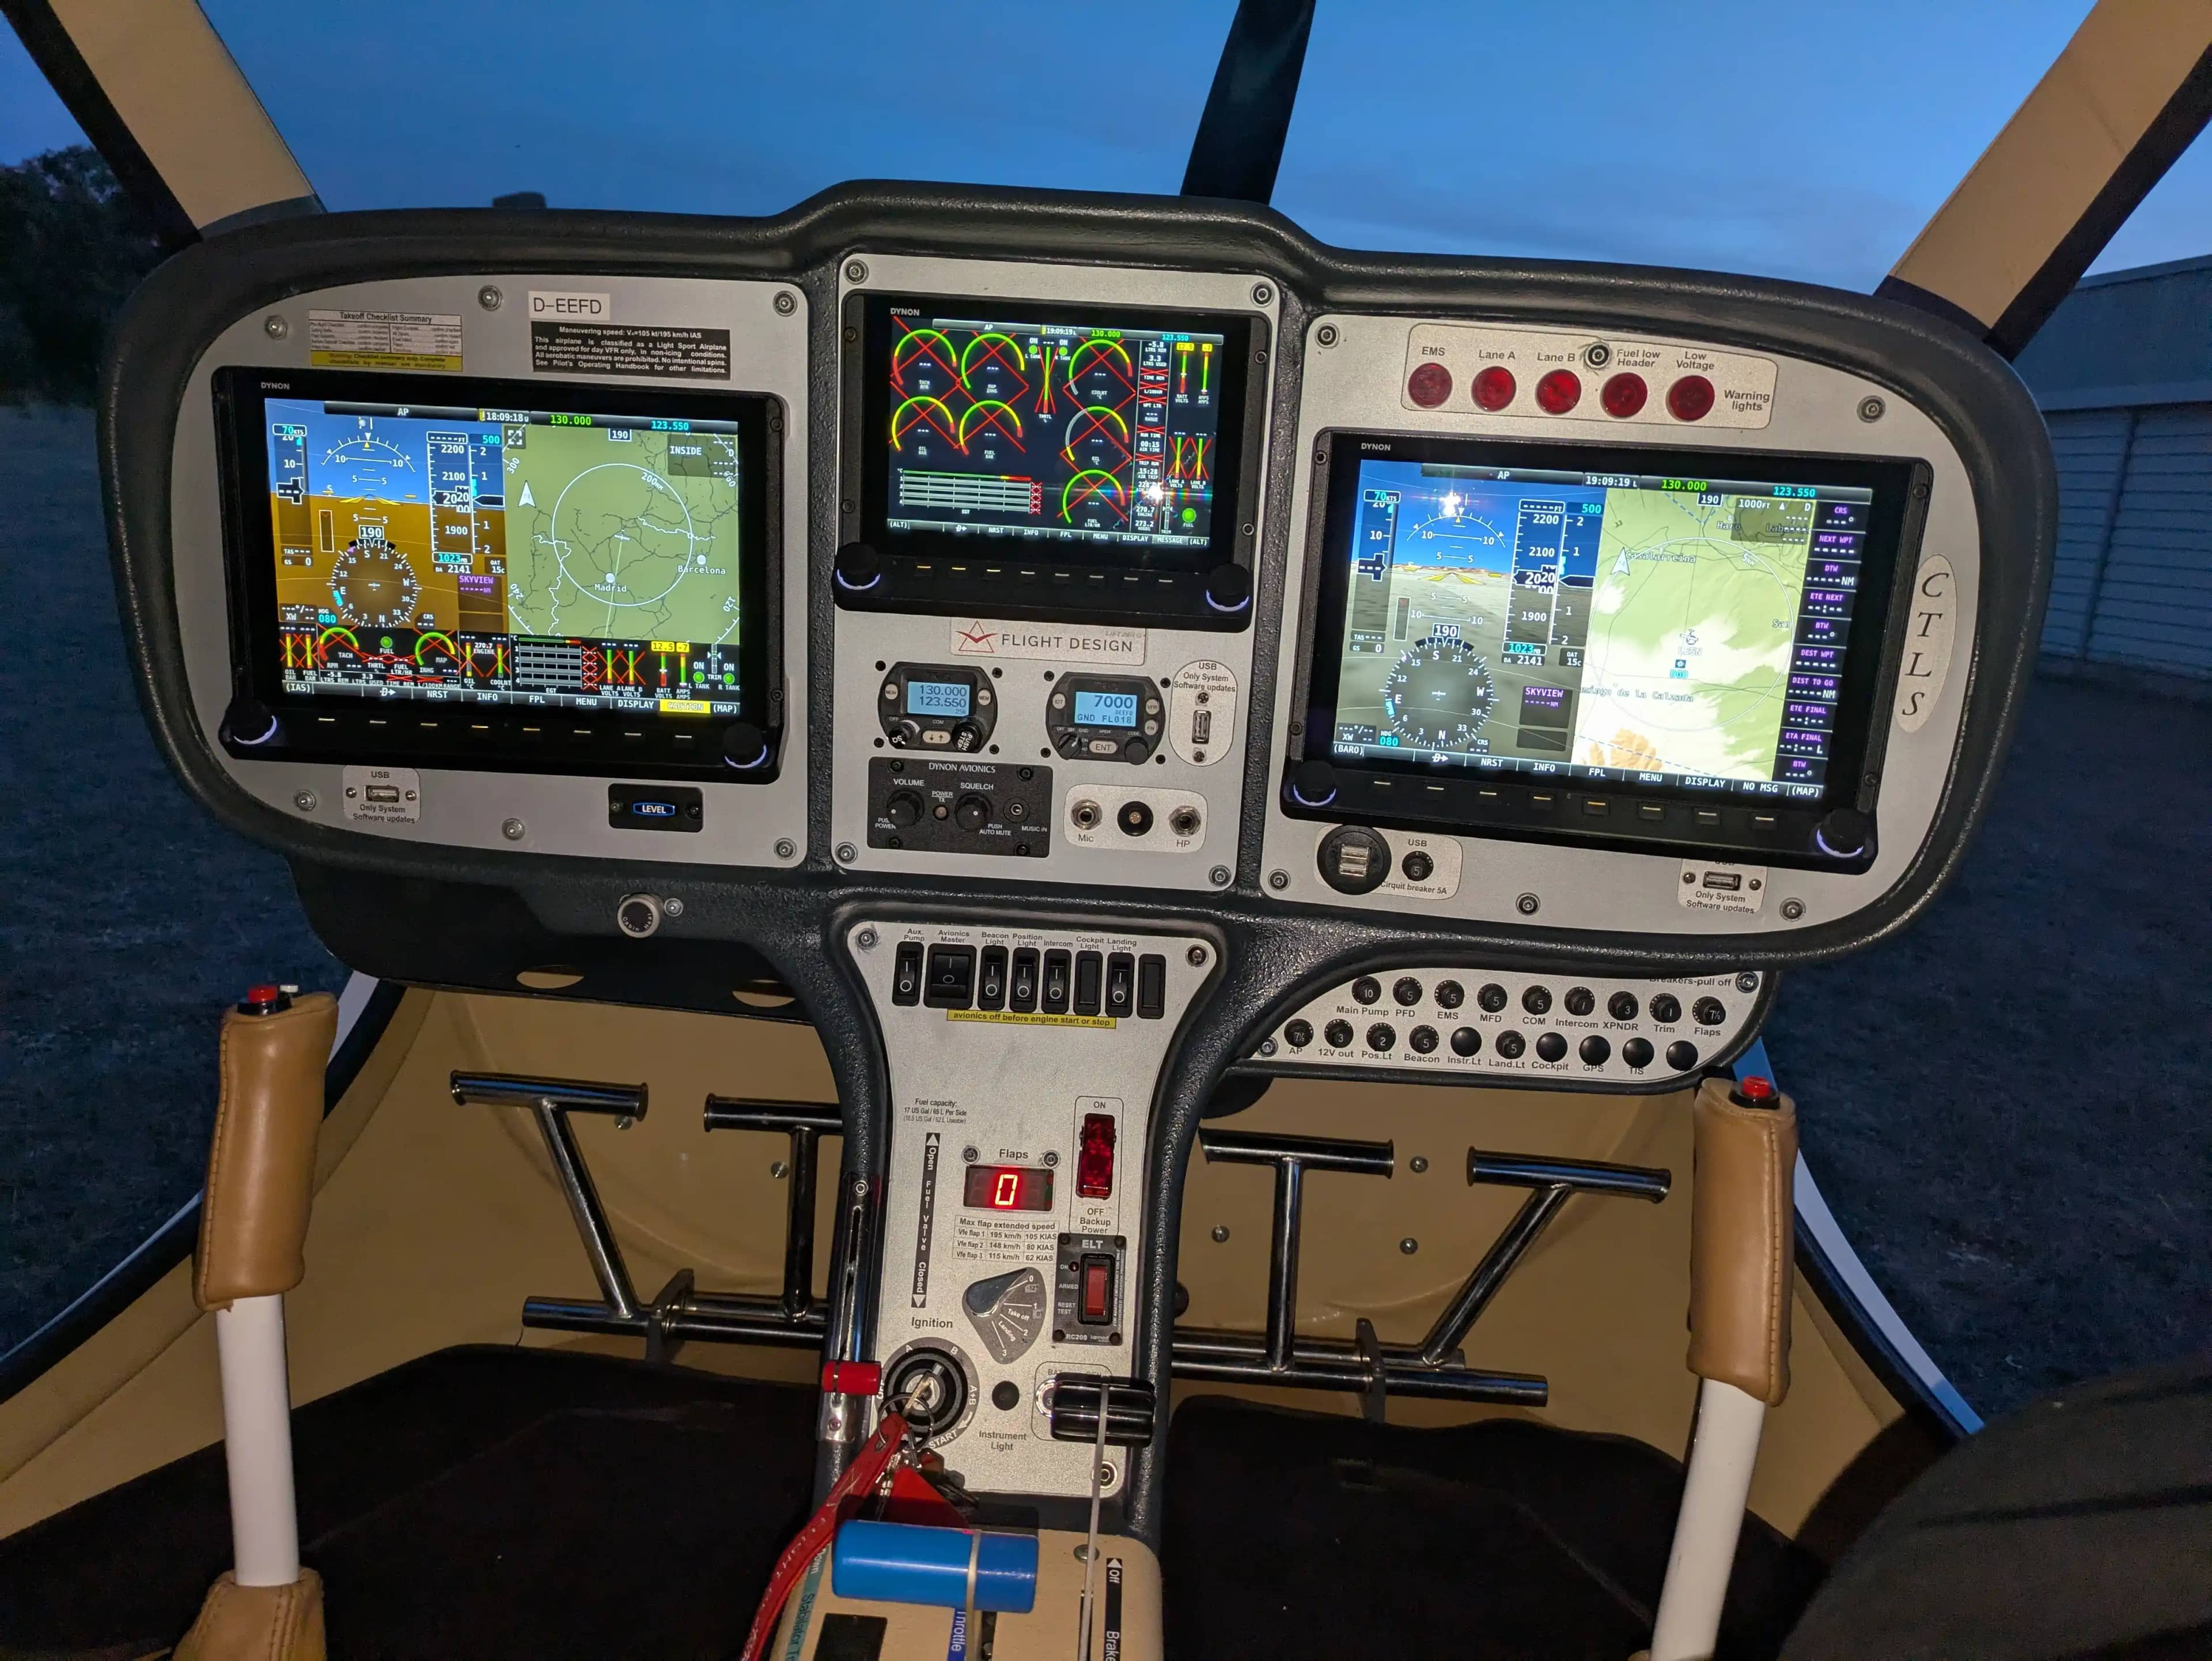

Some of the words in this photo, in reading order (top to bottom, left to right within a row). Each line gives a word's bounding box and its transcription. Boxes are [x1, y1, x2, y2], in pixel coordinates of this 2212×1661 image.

[533, 297, 602, 314] D-EEFD
[891, 308, 919, 316] DYNON
[340, 312, 365, 320] Takeoff
[366, 313, 398, 321] Checklist
[400, 315, 432, 324] Summary
[559, 327, 601, 335] Maneuvering
[603, 328, 625, 337] speed:
[1092, 330, 1120, 338] 130.000
[1422, 346, 1445, 357] EMS
[1479, 350, 1505, 360] Lane
[1508, 350, 1516, 360] A
[1617, 349, 1639, 359] Fuel
[1642, 350, 1661, 360] low
[1684, 351, 1707, 361] Low
[1537, 353, 1564, 362] Lane
[1567, 353, 1575, 362] B
[578, 361, 611, 370] Operating
[1618, 358, 1656, 368] Header
[1676, 360, 1714, 372] Voltage
[1724, 389, 1770, 403] Warning
[1732, 400, 1763, 413] lights
[550, 415, 592, 425] 130.000
[652, 421, 689, 430] 123.550
[441, 445, 464, 453] 2200
[670, 446, 702, 456] INSIDE
[1361, 443, 1391, 451] DYNON
[1661, 480, 1707, 491] 130.000
[1773, 486, 1816, 497] 123.550
[677, 565, 726, 575] Barcelona
[459, 576, 493, 584] SKYVIEW
[594, 584, 627, 593] Madrid
[1002, 634, 1063, 648] FLIGHT
[1070, 638, 1132, 652] DESIGN
[1902, 573, 1949, 716] CTLS
[1183, 672, 1200, 680] Only
[1202, 674, 1229, 683] System
[919, 685, 967, 697] 130.000
[1174, 681, 1205, 690] Software
[1207, 684, 1235, 692] updates
[427, 690, 448, 698] NRST
[618, 700, 654, 709] DISPLAY
[713, 705, 737, 713] (MAP)
[919, 697, 966, 707] 123.550
[1094, 695, 1133, 709] 7000
[1102, 716, 1131, 724] FL018
[1096, 743, 1111, 751] ENT
[929, 763, 957, 771] DYNON
[959, 765, 995, 773] AVIONICS
[1589, 768, 1605, 777] FPL
[1639, 773, 1662, 782] MENU
[1685, 777, 1726, 787] DISPLAY
[1791, 786, 1819, 797] (MAP)
[360, 804, 376, 812] Only
[378, 805, 405, 814] System
[642, 805, 666, 814] LEVEL
[353, 814, 385, 822] Software
[387, 815, 415, 823] updates
[1078, 834, 1093, 842] Mic
[1176, 840, 1190, 848] HP
[1381, 880, 1406, 890] Cirquit
[1407, 884, 1435, 893] breaker
[1696, 891, 1714, 901] Only
[1716, 893, 1745, 902] System
[1687, 900, 1721, 910] Software
[1723, 906, 1754, 914] updates
[1107, 938, 1137, 947] Landing
[1336, 1006, 1359, 1015] Main
[1362, 1007, 1388, 1017] Pump
[1395, 1009, 1415, 1017] PFD
[1437, 1012, 1459, 1020] EMS
[1003, 1014, 1028, 1022] before
[1480, 1014, 1502, 1023] MFD
[1522, 1016, 1546, 1026] COM
[1555, 1019, 1599, 1029] Intercom
[1603, 1021, 1638, 1031] XPNDR
[1654, 1024, 1675, 1033] Trim
[1694, 1027, 1721, 1036] Flaps
[1289, 1047, 1302, 1055] AP
[1318, 1048, 1336, 1057] 12V
[1339, 1050, 1353, 1058] out
[1362, 1051, 1392, 1061] Pos.Lt
[1404, 1053, 1440, 1063] Beacon
[1447, 1056, 1481, 1066] Instr.Lt
[1488, 1059, 1525, 1070] Land.Lt
[1532, 1061, 1569, 1071] Cockpit
[930, 1100, 957, 1108] capacity:
[927, 1147, 936, 1170] Open
[999, 1149, 1028, 1160] Flaps
[995, 1174, 1018, 1206] 0
[960, 1218, 975, 1226] Max
[978, 1220, 991, 1228] flap
[994, 1221, 1029, 1229] extended
[1032, 1223, 1055, 1231] speed
[1080, 1217, 1111, 1226] Backup
[921, 1215, 929, 1250] Valve
[1082, 1226, 1108, 1234] Power
[1082, 1240, 1103, 1249] ELT
[916, 1262, 926, 1293] Closed
[911, 1316, 953, 1329] Ignition
[979, 1430, 1027, 1440] Instrument
[991, 1442, 1013, 1451] Light
[1109, 1569, 1120, 1584] Off
